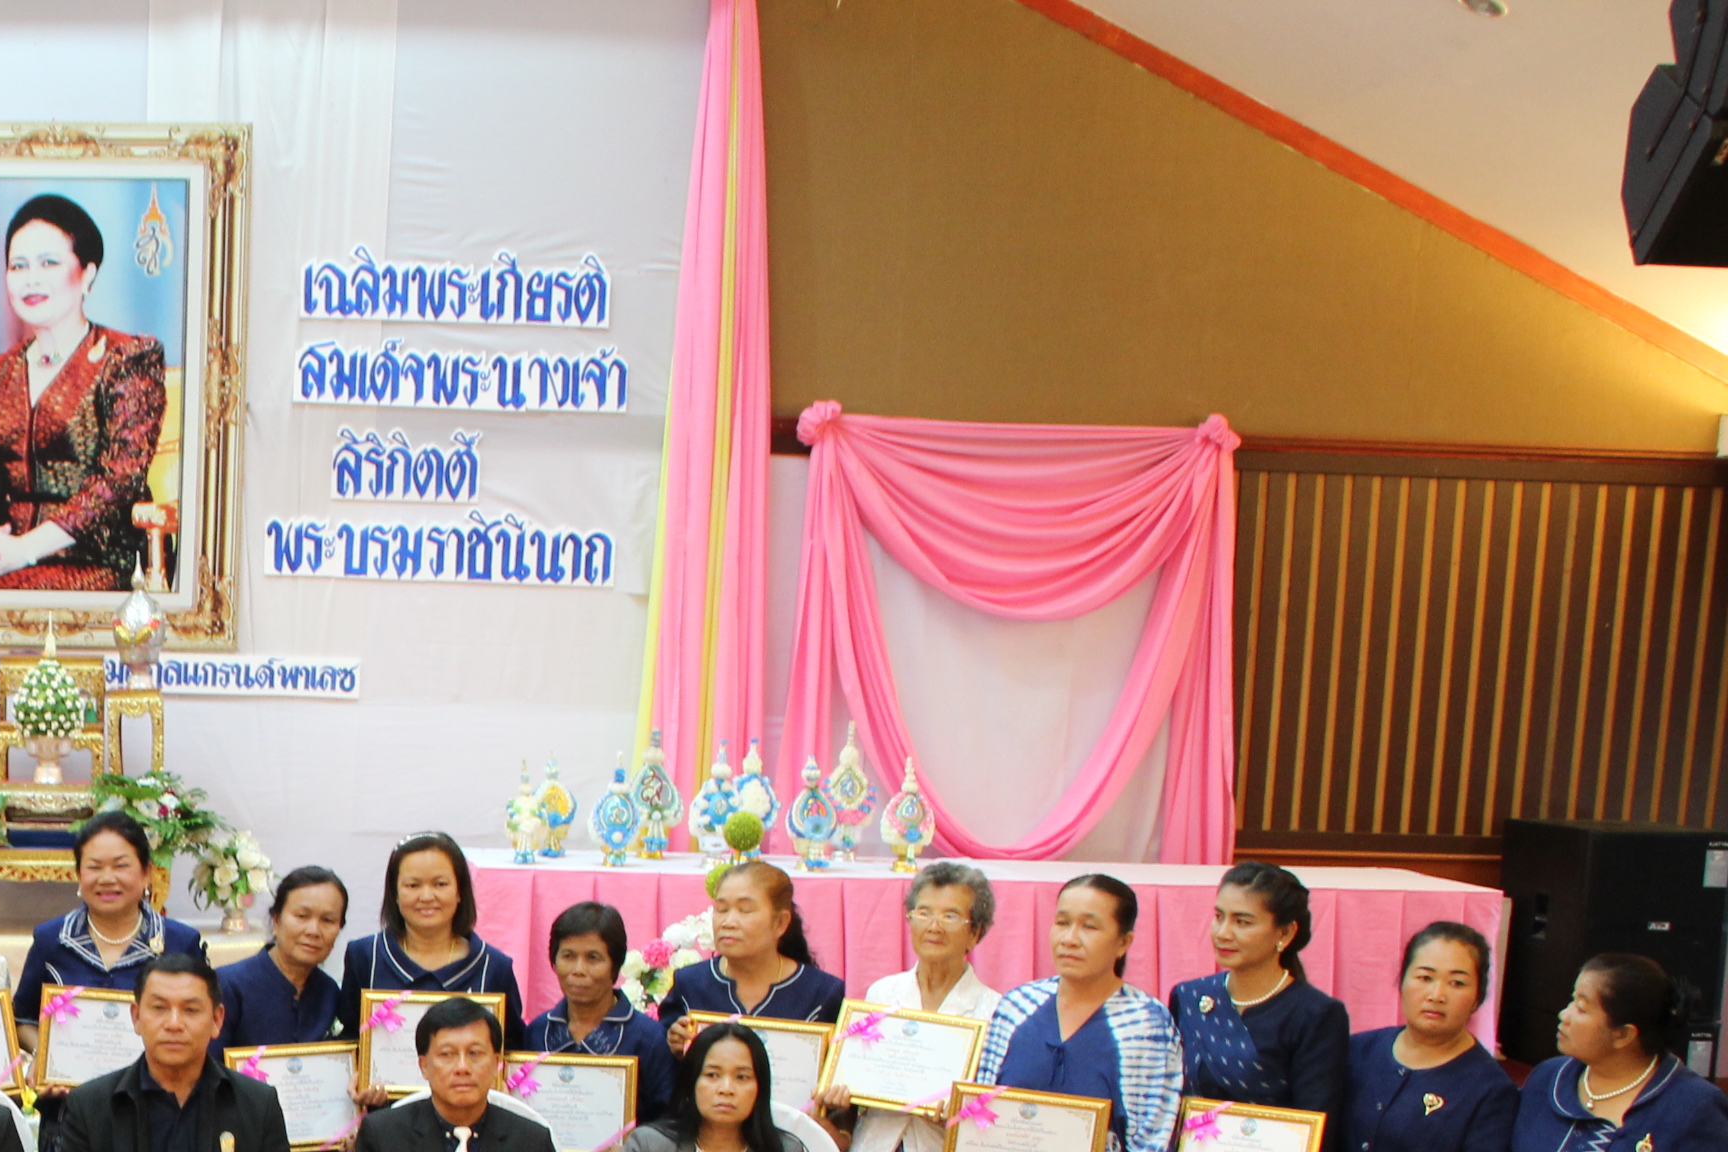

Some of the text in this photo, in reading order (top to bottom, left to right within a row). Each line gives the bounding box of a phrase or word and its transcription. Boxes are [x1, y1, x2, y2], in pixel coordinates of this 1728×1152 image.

[304, 245, 608, 324] เฉลิมพระเกียรติ
[299, 339, 628, 409] สมเด็จพระนางเจ้า
[267, 510, 613, 584] พระบรมราชินีนาถ
